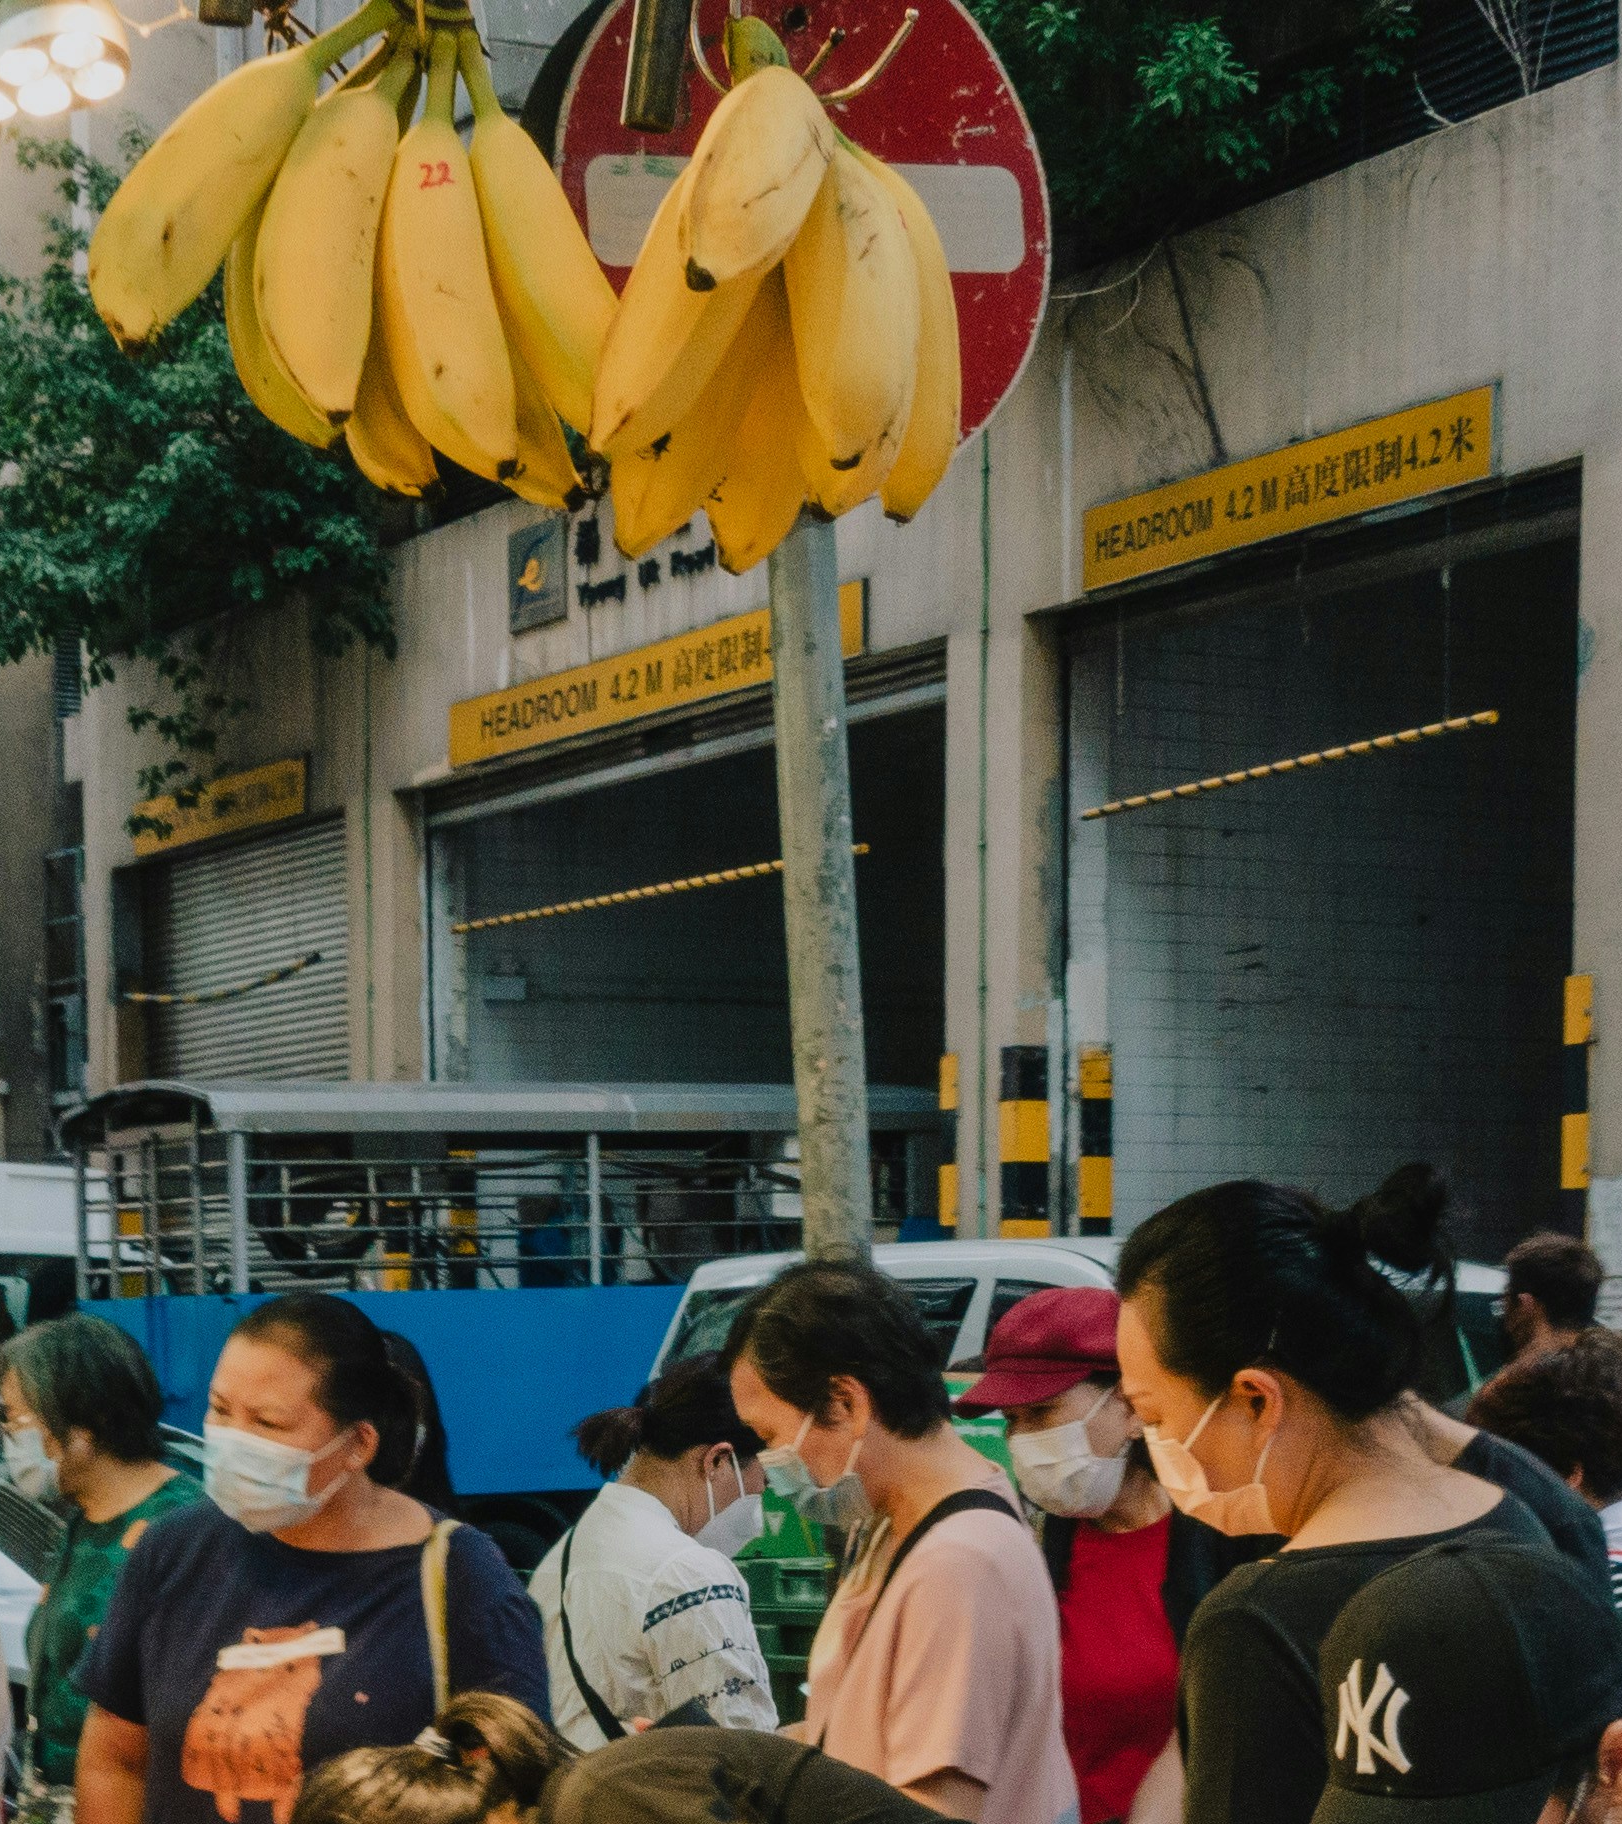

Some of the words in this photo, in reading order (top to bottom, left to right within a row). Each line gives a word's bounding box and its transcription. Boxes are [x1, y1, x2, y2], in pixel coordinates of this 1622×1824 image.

[419, 160, 455, 190] 22
[1095, 497, 1214, 561] HEADROOM
[1224, 485, 1253, 523] 4.2
[1259, 478, 1280, 514] M
[480, 680, 597, 739] HEADROOM
[610, 669, 639, 703] 4.2
[645, 661, 664, 696] M
[673, 626, 771, 693] 高度限制
[1335, 1658, 1412, 1774] NY
